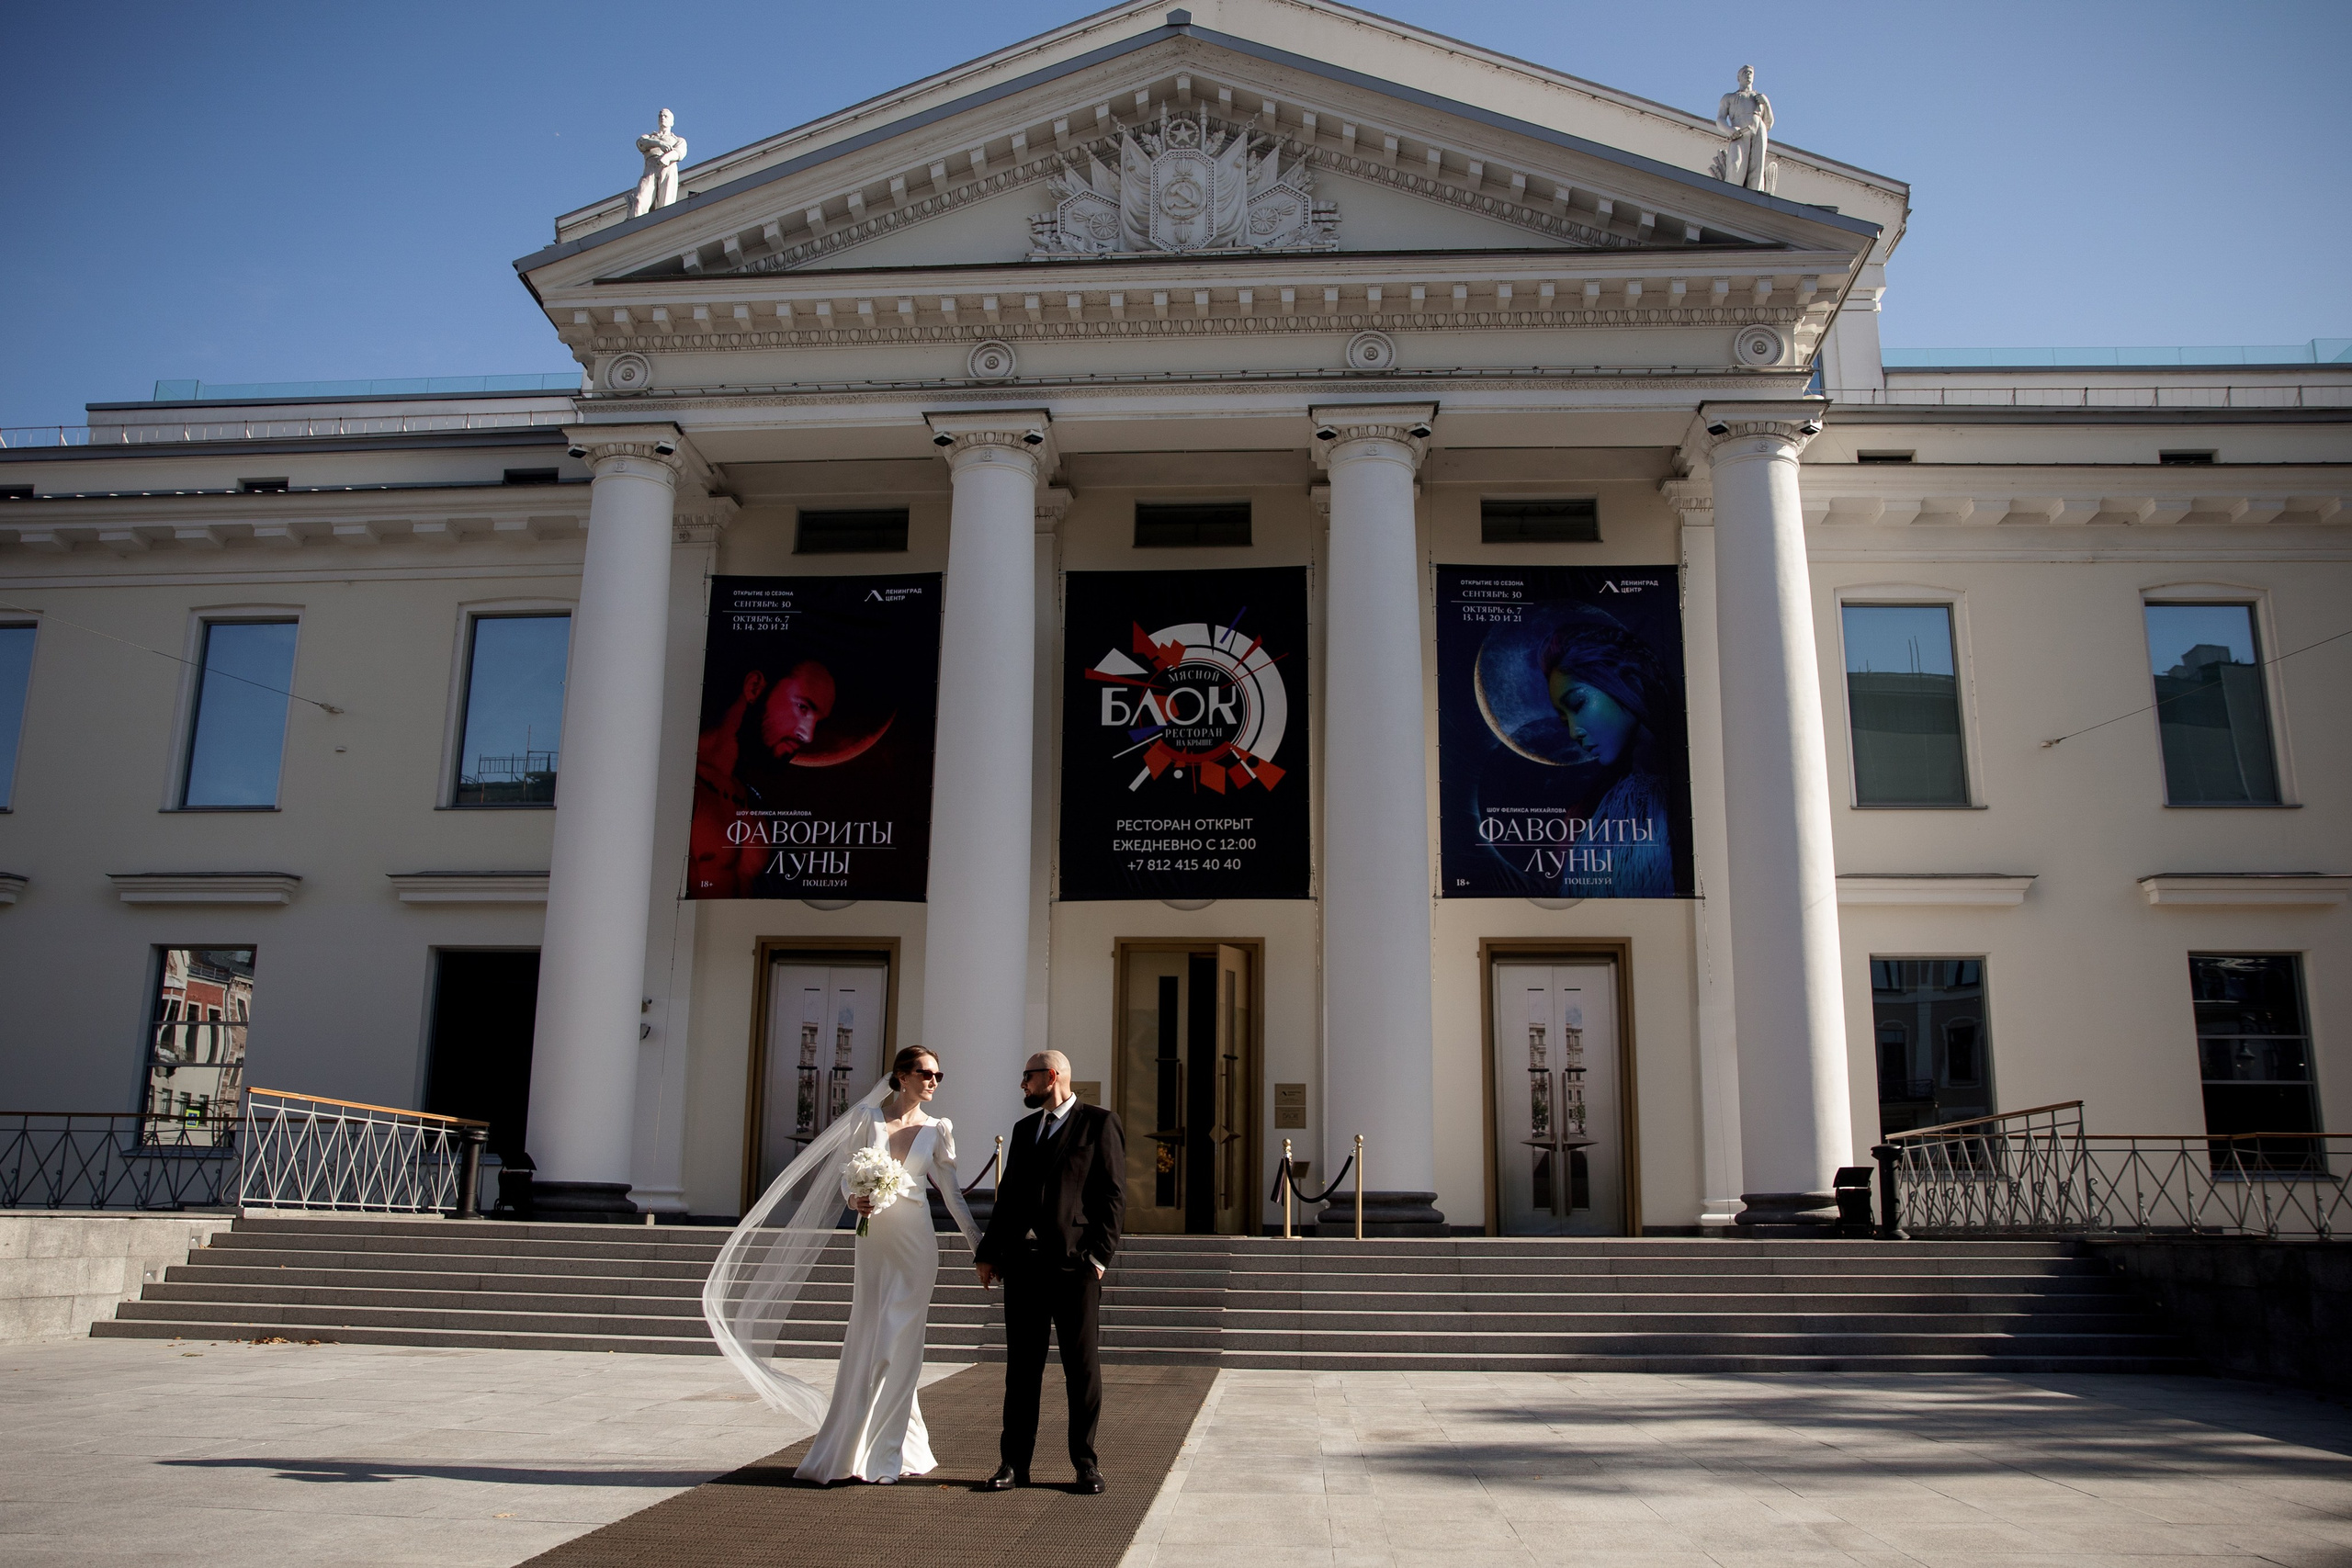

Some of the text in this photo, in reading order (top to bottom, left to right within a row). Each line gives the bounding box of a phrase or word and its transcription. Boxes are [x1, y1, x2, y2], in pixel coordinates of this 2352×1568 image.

[1462, 590, 1522, 599] СЕНТЯБРЬ: 30
[1463, 605, 1504, 614] ОКТЯБРЬ:
[1168, 670, 1220, 683] МЯСНОЙ
[1101, 685, 1238, 726] БЛОК
[1165, 728, 1222, 739] РЕСТОРАН
[1187, 739, 1213, 747] КРЫШЕ
[1116, 818, 1253, 831] РЕСТОРАН ОТКРЫТ
[1478, 817, 1654, 842] ФАВОРИТЫ
[726, 819, 893, 845] ФАВОРИТЫ
[1113, 838, 1257, 852] ЕЖЕДНЕВНО С 12:00
[765, 851, 851, 880] ЛУНЫ
[1126, 858, 1241, 871] +7 812 415 40 40
[1524, 849, 1612, 879] ЛУНЫ
[700, 880, 713, 888] 18+
[802, 879, 847, 887] ПОЦЕЛУЙ
[1456, 878, 1471, 886] 18+
[1564, 876, 1612, 886] ПОЦЕЛУЙ
